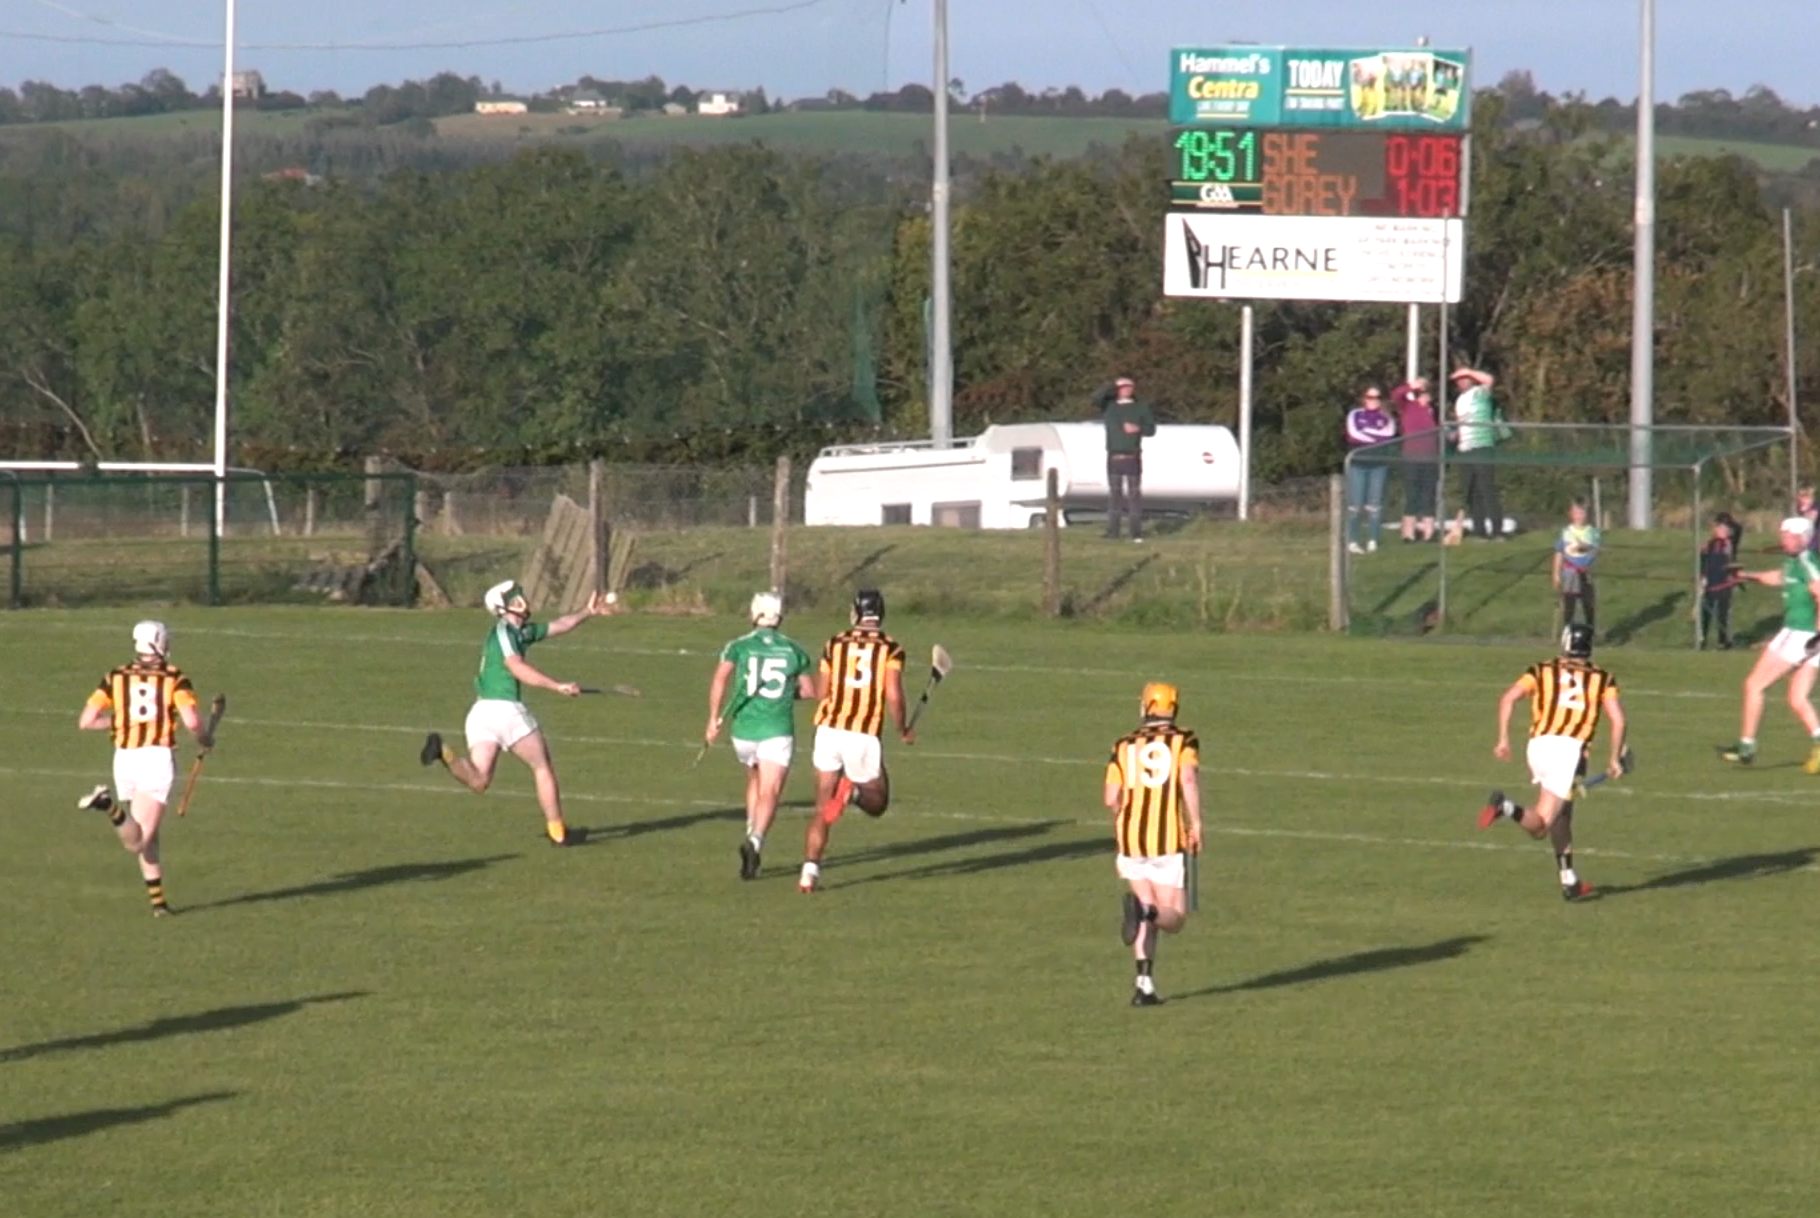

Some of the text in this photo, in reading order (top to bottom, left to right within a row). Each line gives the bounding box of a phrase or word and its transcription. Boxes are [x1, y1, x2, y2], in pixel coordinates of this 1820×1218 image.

[1180, 53, 1271, 75] Hammel's
[1288, 59, 1344, 88] TODAY
[1188, 77, 1260, 99] Centra
[1174, 131, 1254, 181] 19:51
[1262, 133, 1318, 175] SHE
[1262, 175, 1357, 215] GOREY
[744, 656, 788, 699] 15
[845, 648, 872, 688] 3
[130, 682, 157, 722] 8
[1126, 741, 1172, 789] 19
